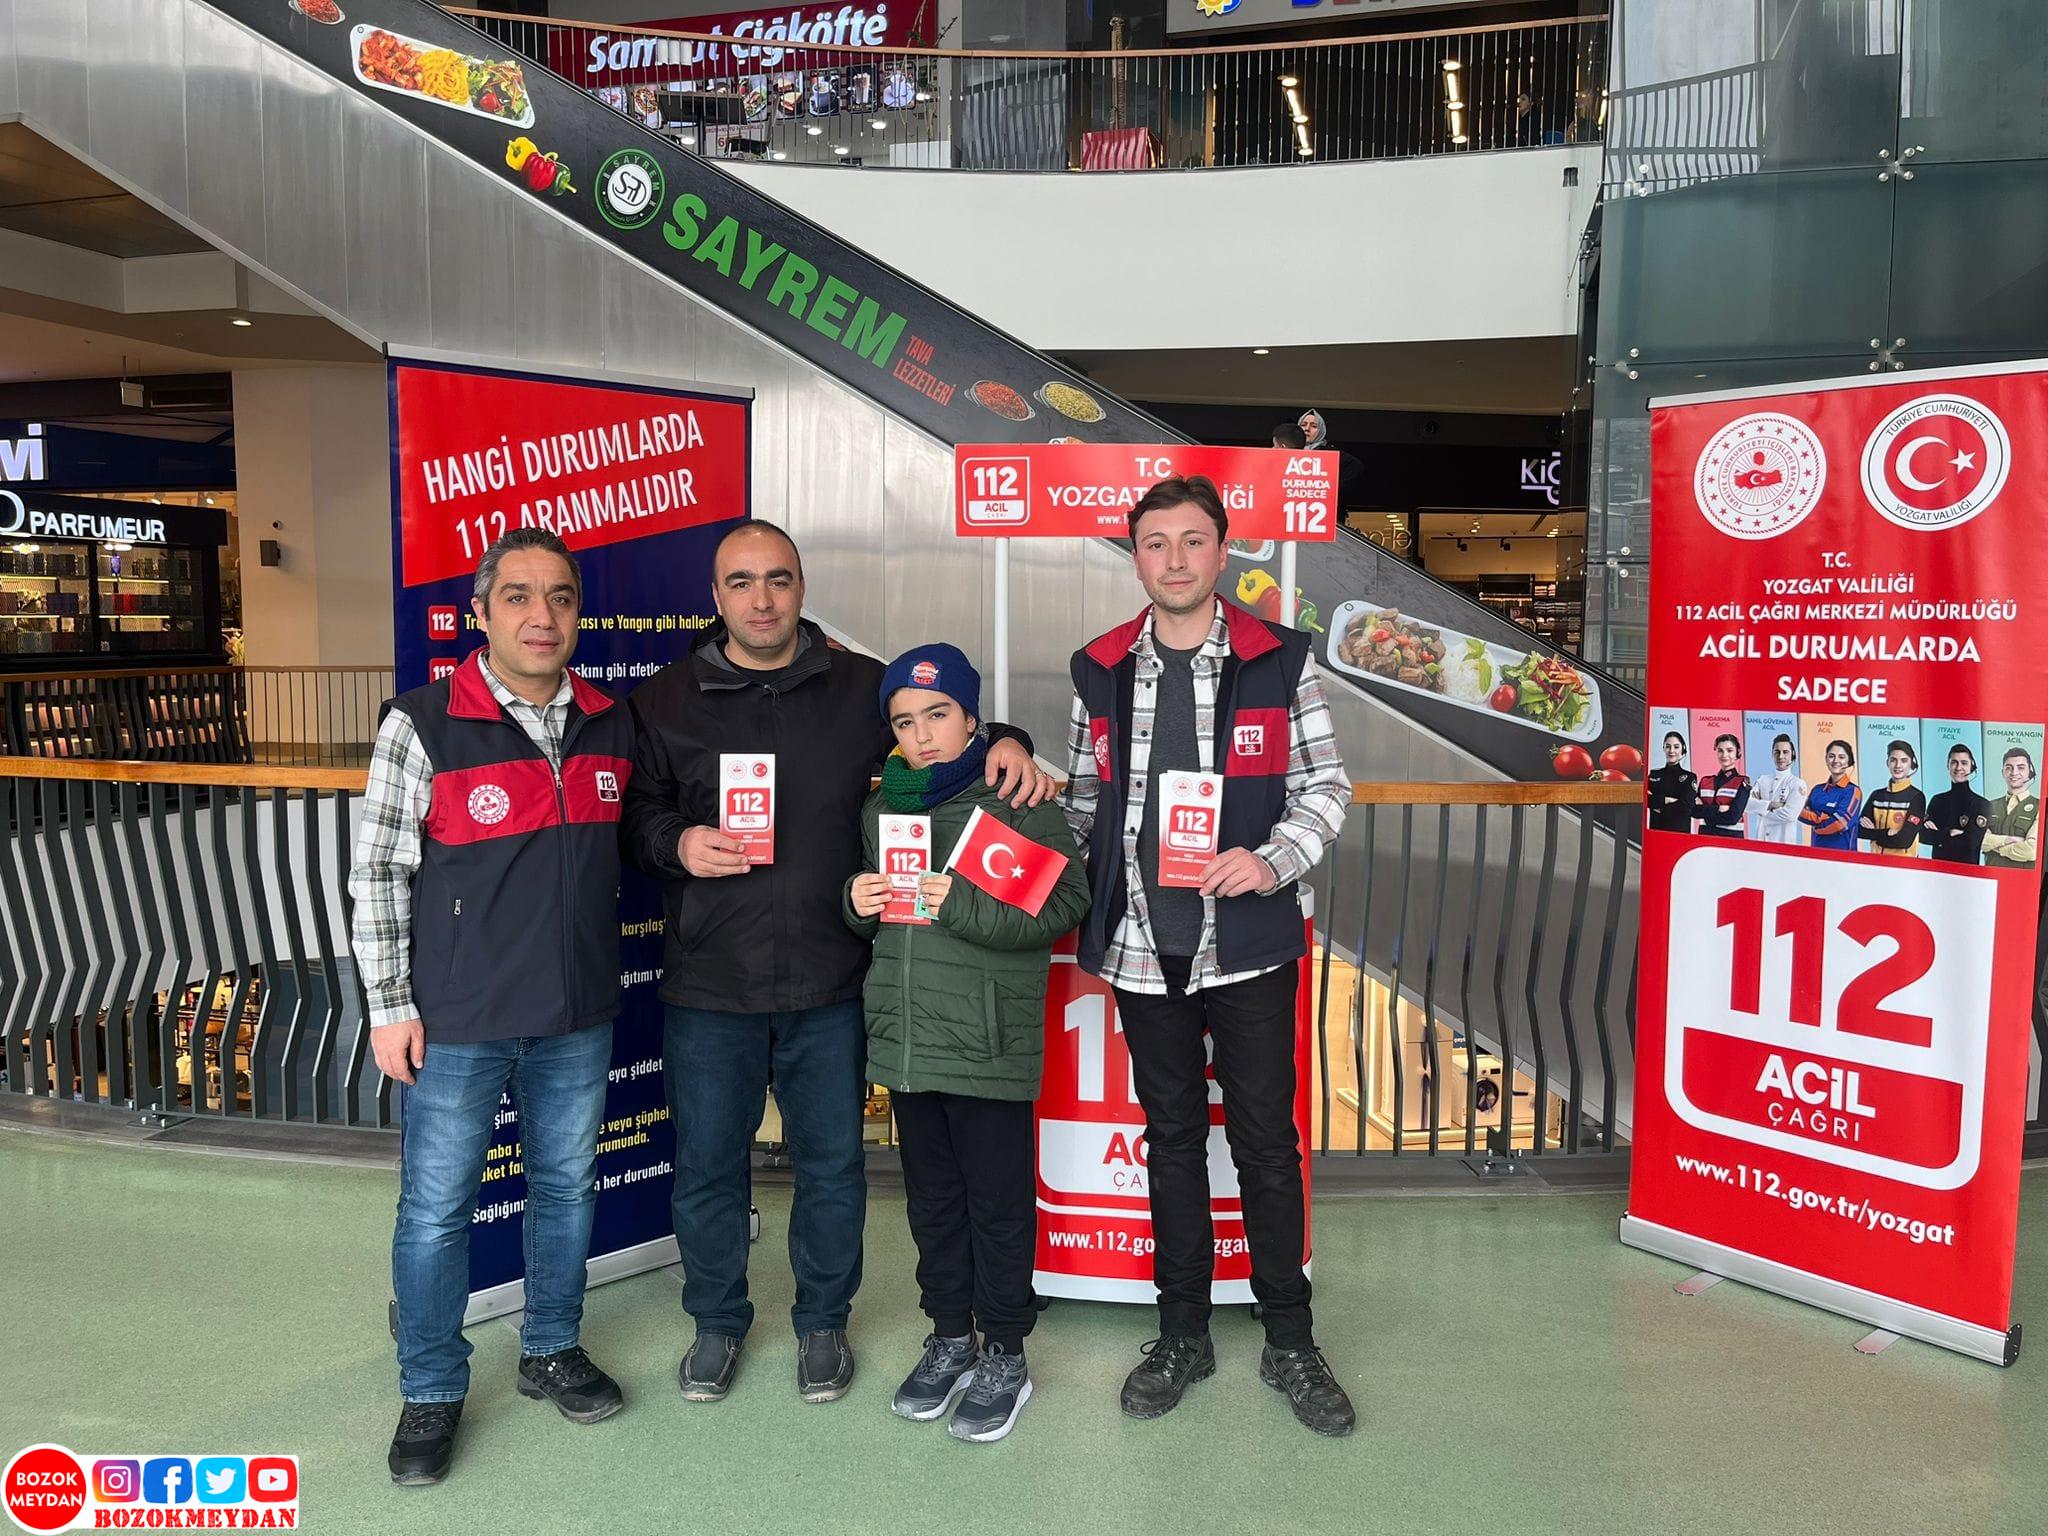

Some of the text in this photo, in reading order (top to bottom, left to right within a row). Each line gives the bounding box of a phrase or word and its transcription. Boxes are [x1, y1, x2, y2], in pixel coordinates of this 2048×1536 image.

[613, 156, 660, 191] SAYREM
[662, 193, 908, 369] SAYREM
[906, 334, 935, 366] TAVA
[893, 358, 958, 406] LEZZETLERİ
[421, 409, 705, 504] HANGİ DURUMLARDA
[973, 466, 1018, 496] 112
[1281, 479, 1331, 490] DURUMDA
[1286, 488, 1327, 499] SADECE
[520, 468, 698, 538] ARANMALIDIR
[1046, 485, 1148, 508] YOZGAT
[29, 511, 165, 541] PARFUMEUR
[1283, 501, 1328, 534] 112
[1894, 503, 1932, 521] YOZGAT
[1821, 551, 1851, 568] T.C.
[1763, 572, 1915, 595] YOZGAT VALİLİĞİ
[432, 613, 455, 631] 112
[601, 618, 614, 629] ve
[616, 614, 653, 632] Yangın
[655, 615, 676, 632] gibi
[1675, 598, 2017, 624] 112 ACİL ÇAĞRI MERKEZİ MÜDÜRLÜĞÜ
[1698, 628, 1982, 662] ACİL DURUMLARDA
[606, 662, 626, 681] gibi
[1777, 676, 1888, 704] SADECE
[1238, 729, 1260, 743] 112
[600, 775, 615, 789] 112
[732, 792, 764, 813] 112
[1176, 809, 1208, 833] 112
[892, 851, 921, 873] 112
[1716, 886, 1936, 1049] 112
[630, 1058, 663, 1080] şiddet
[1754, 1054, 1877, 1119] ACİL
[487, 1144, 512, 1161] mba
[608, 1116, 632, 1133] veya
[635, 1105, 671, 1130] şüphel
[1767, 1100, 1859, 1142] ÇAĞRI
[603, 1174, 621, 1190] her
[624, 1161, 673, 1184] durumda.
[1675, 1153, 1955, 1247] www.112.gov.tr/yozgat
